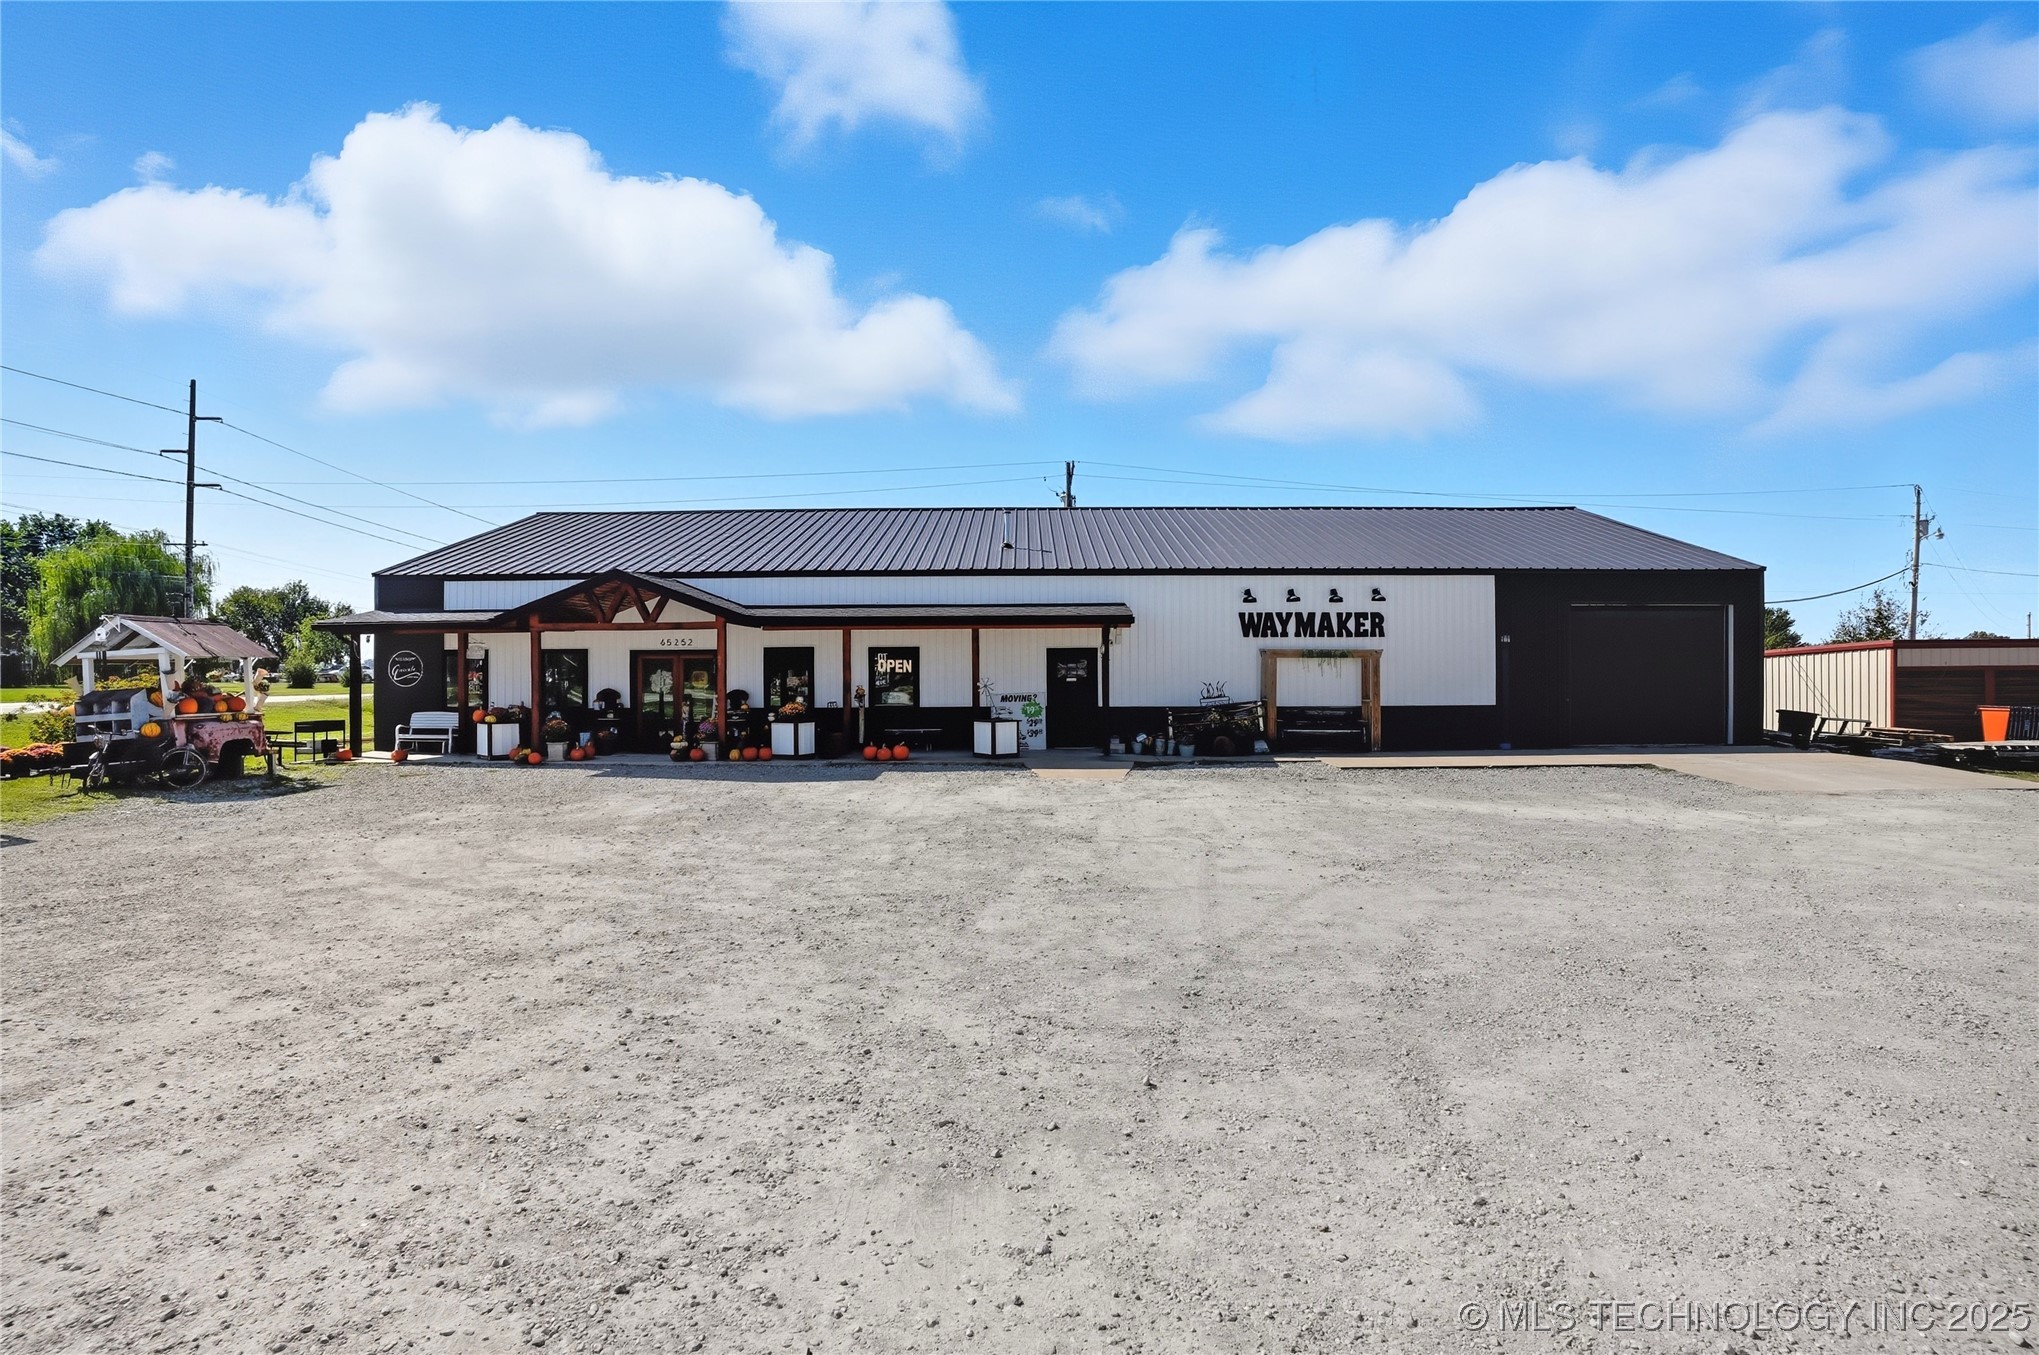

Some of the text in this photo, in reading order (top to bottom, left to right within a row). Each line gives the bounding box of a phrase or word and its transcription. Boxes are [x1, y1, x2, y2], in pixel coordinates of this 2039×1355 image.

[1238, 612, 1386, 638] WAYMAKER
[660, 638, 693, 647] 65252
[877, 659, 912, 673] OPEN
